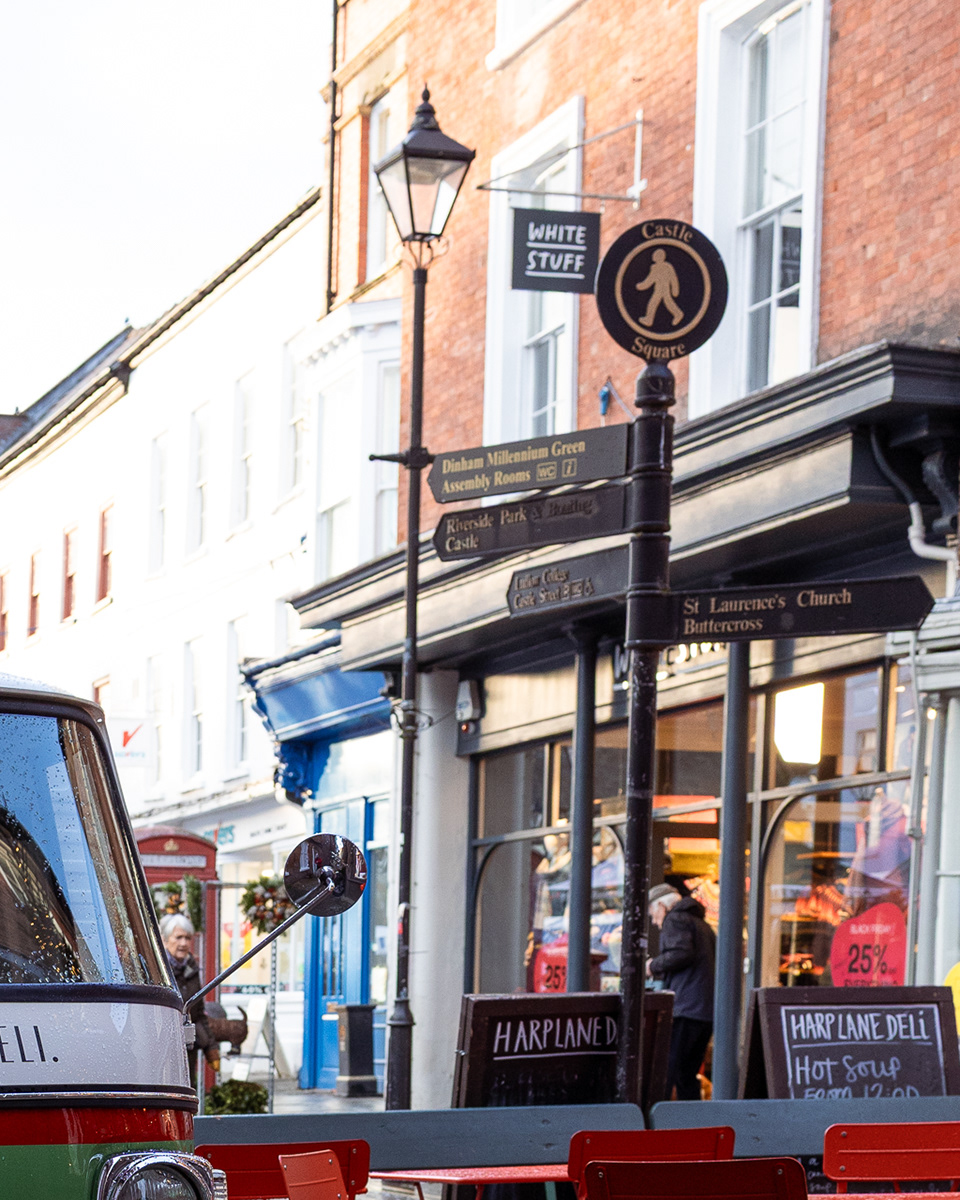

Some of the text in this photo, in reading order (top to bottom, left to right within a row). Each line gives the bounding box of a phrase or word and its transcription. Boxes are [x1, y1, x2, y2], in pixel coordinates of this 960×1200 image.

[528, 222, 587, 244] WHITE
[642, 222, 693, 243] Castle
[526, 250, 585, 272] STUFF
[632, 336, 686, 360] Square
[442, 440, 586, 474] Dinham Millennium Green
[442, 473, 492, 493] Assembly
[494, 470, 531, 487] Rooms
[538, 463, 557, 480] WC
[446, 513, 494, 534] Riverside
[500, 507, 527, 526] Park
[445, 535, 480, 553] Castle
[683, 588, 852, 615] St Laurence's Church
[683, 617, 764, 636] Buttercross
[847, 943, 888, 974] 25%
